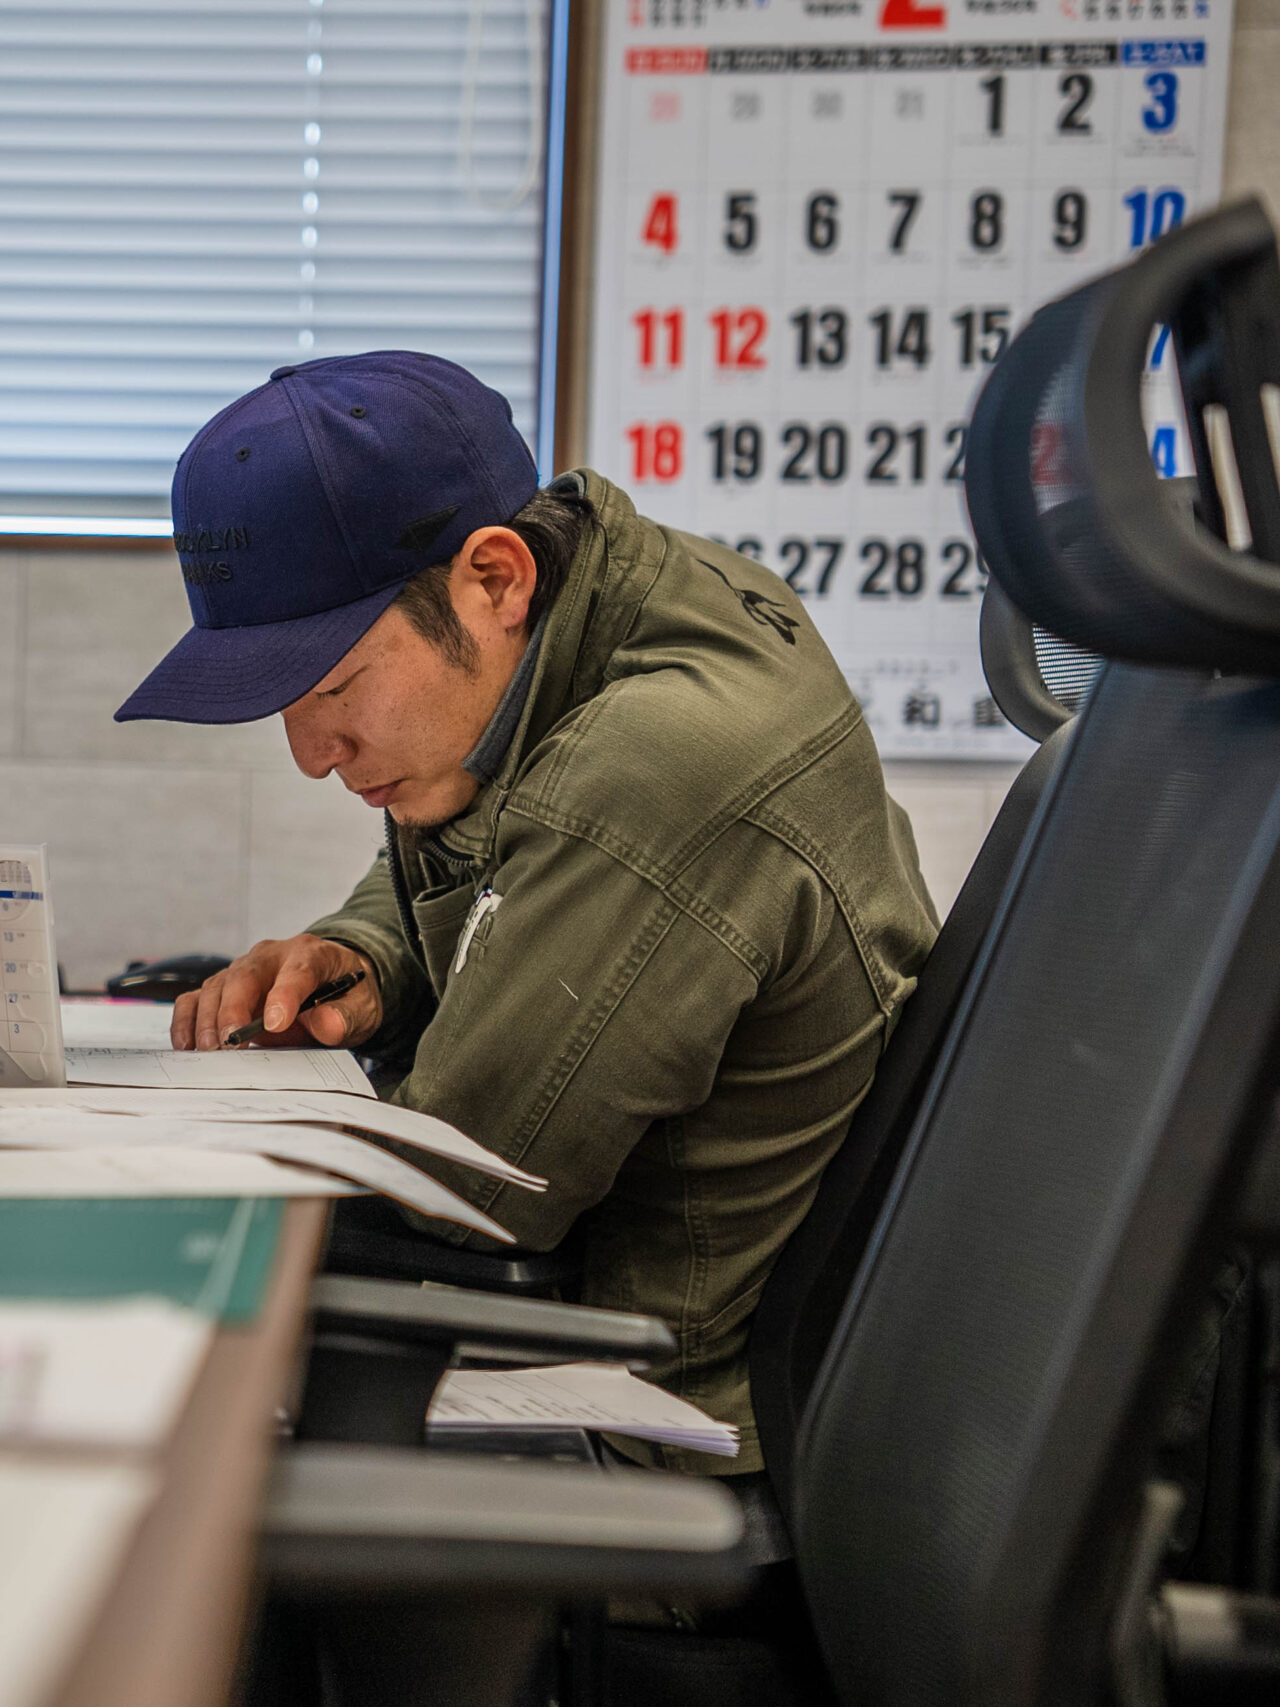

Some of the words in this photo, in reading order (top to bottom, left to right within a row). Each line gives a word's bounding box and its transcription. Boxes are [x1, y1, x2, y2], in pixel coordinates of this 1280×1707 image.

[980, 72, 1006, 136] 1
[1057, 71, 1094, 135] 2
[1142, 71, 1178, 134] 3
[643, 193, 677, 254] 4
[724, 192, 758, 254] 5
[805, 191, 839, 254] 6
[888, 191, 921, 254] 7
[969, 190, 1004, 253] 8
[1052, 189, 1088, 253] 9
[1123, 189, 1186, 248] 10
[634, 309, 683, 368] 11
[710, 308, 767, 370] 12
[790, 308, 849, 369] 13
[869, 308, 931, 369] 14
[954, 308, 1011, 366] 15
[627, 422, 682, 482] 18
[706, 422, 763, 483] 19
[780, 423, 849, 484] 20
[865, 423, 927, 484] 21
[780, 540, 842, 595] 27
[858, 540, 926, 597] 28
[14, 1023, 20, 1034] 3
